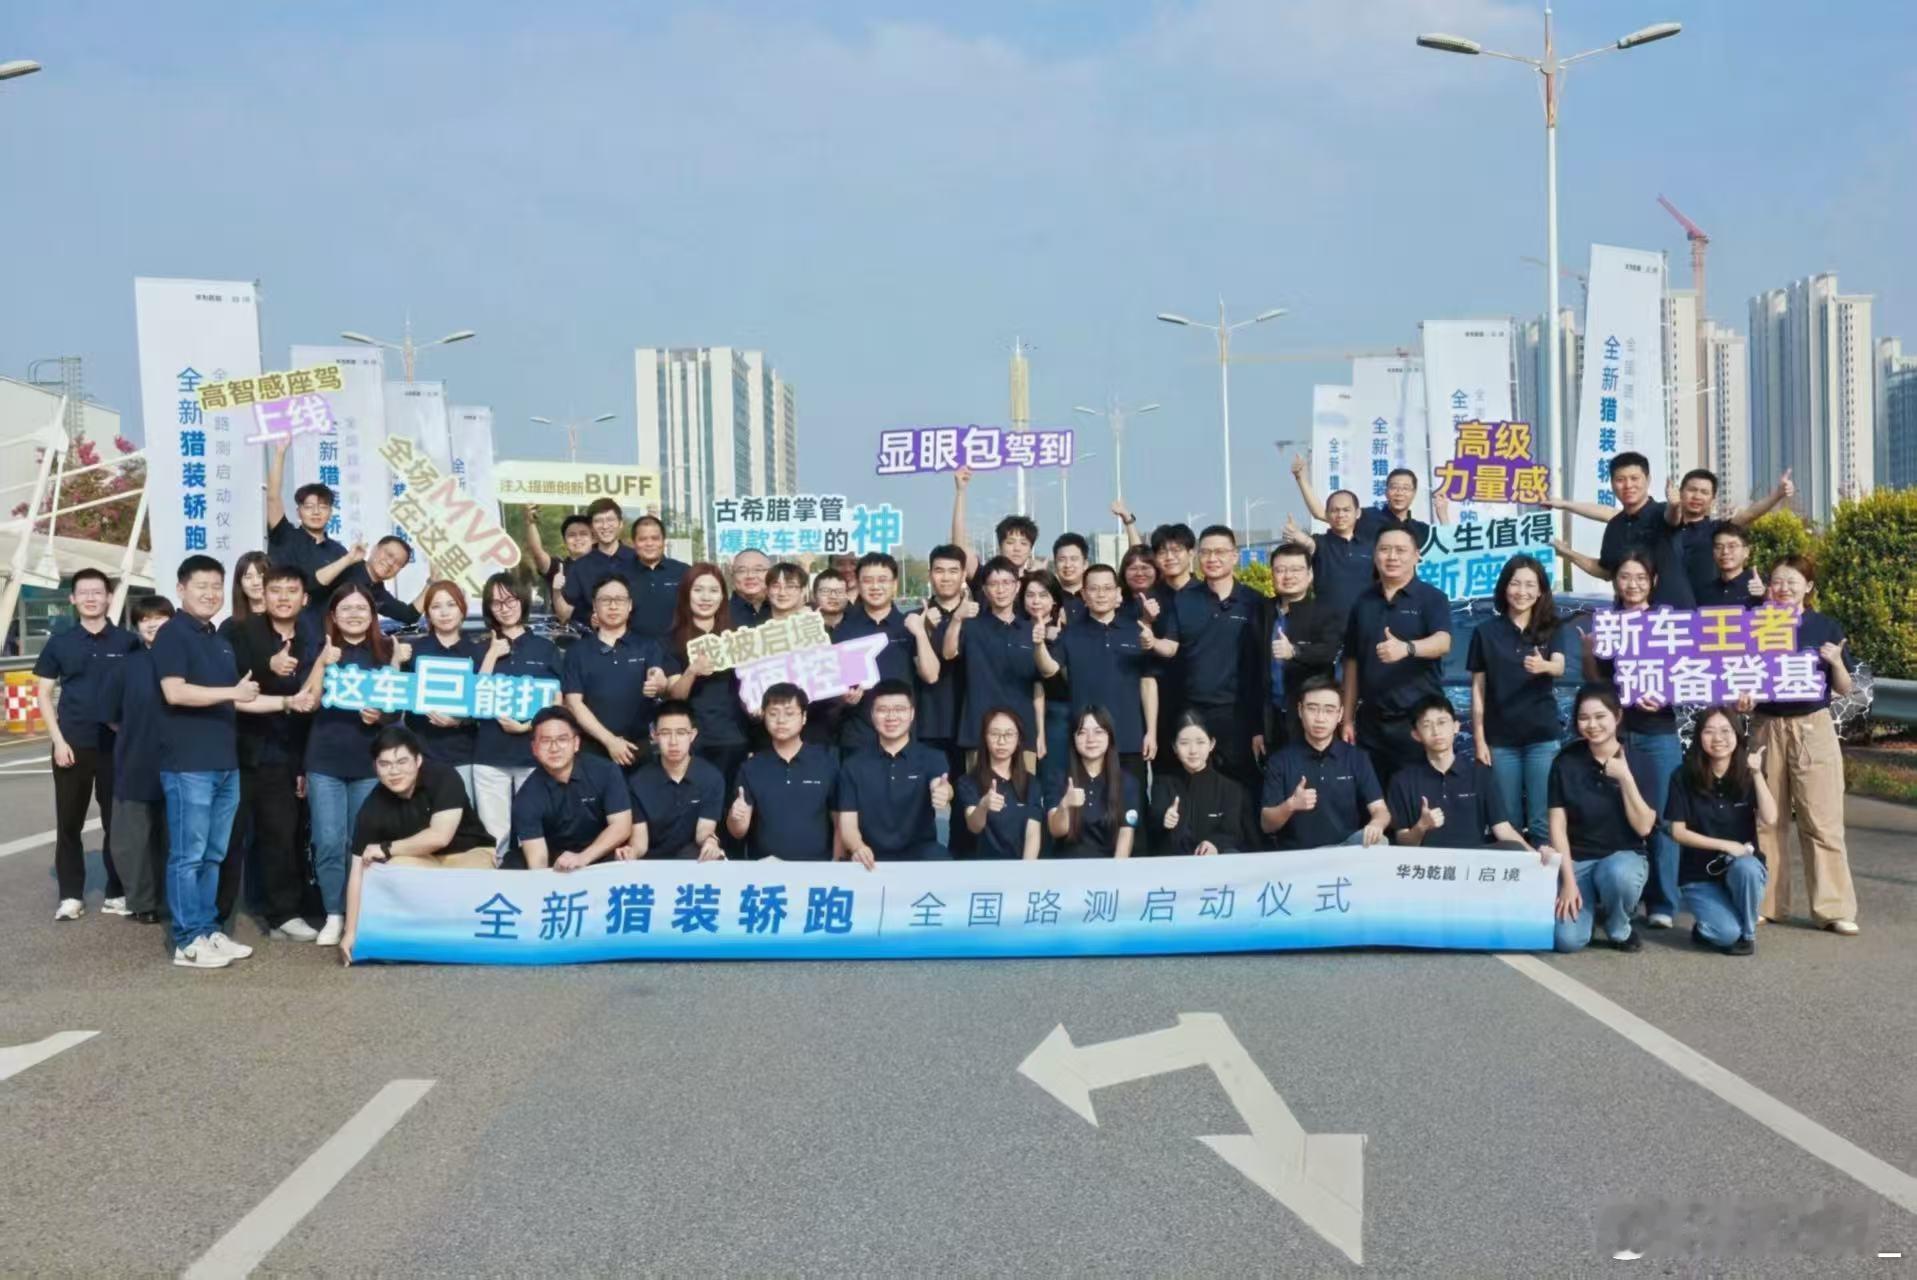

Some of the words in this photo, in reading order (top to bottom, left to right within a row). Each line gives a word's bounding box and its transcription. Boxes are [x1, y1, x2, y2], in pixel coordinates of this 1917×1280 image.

[198, 366, 342, 410] 高智感座驾
[247, 396, 331, 442] 上线
[1457, 421, 1531, 460] 高级
[878, 426, 1072, 473] 显眼包驾到
[1435, 463, 1549, 502] 力量感
[715, 497, 844, 522] 古希腊掌管
[1420, 513, 1554, 557] 人生值得
[1595, 605, 1799, 657] 新车王者
[325, 658, 557, 718] 这车巨能打
[1617, 653, 1823, 704] 预备登基
[1478, 867, 1520, 881] 启境
[473, 884, 853, 941] 全新猎装轿跑
[909, 877, 1353, 928] 全国路测启动仪式
